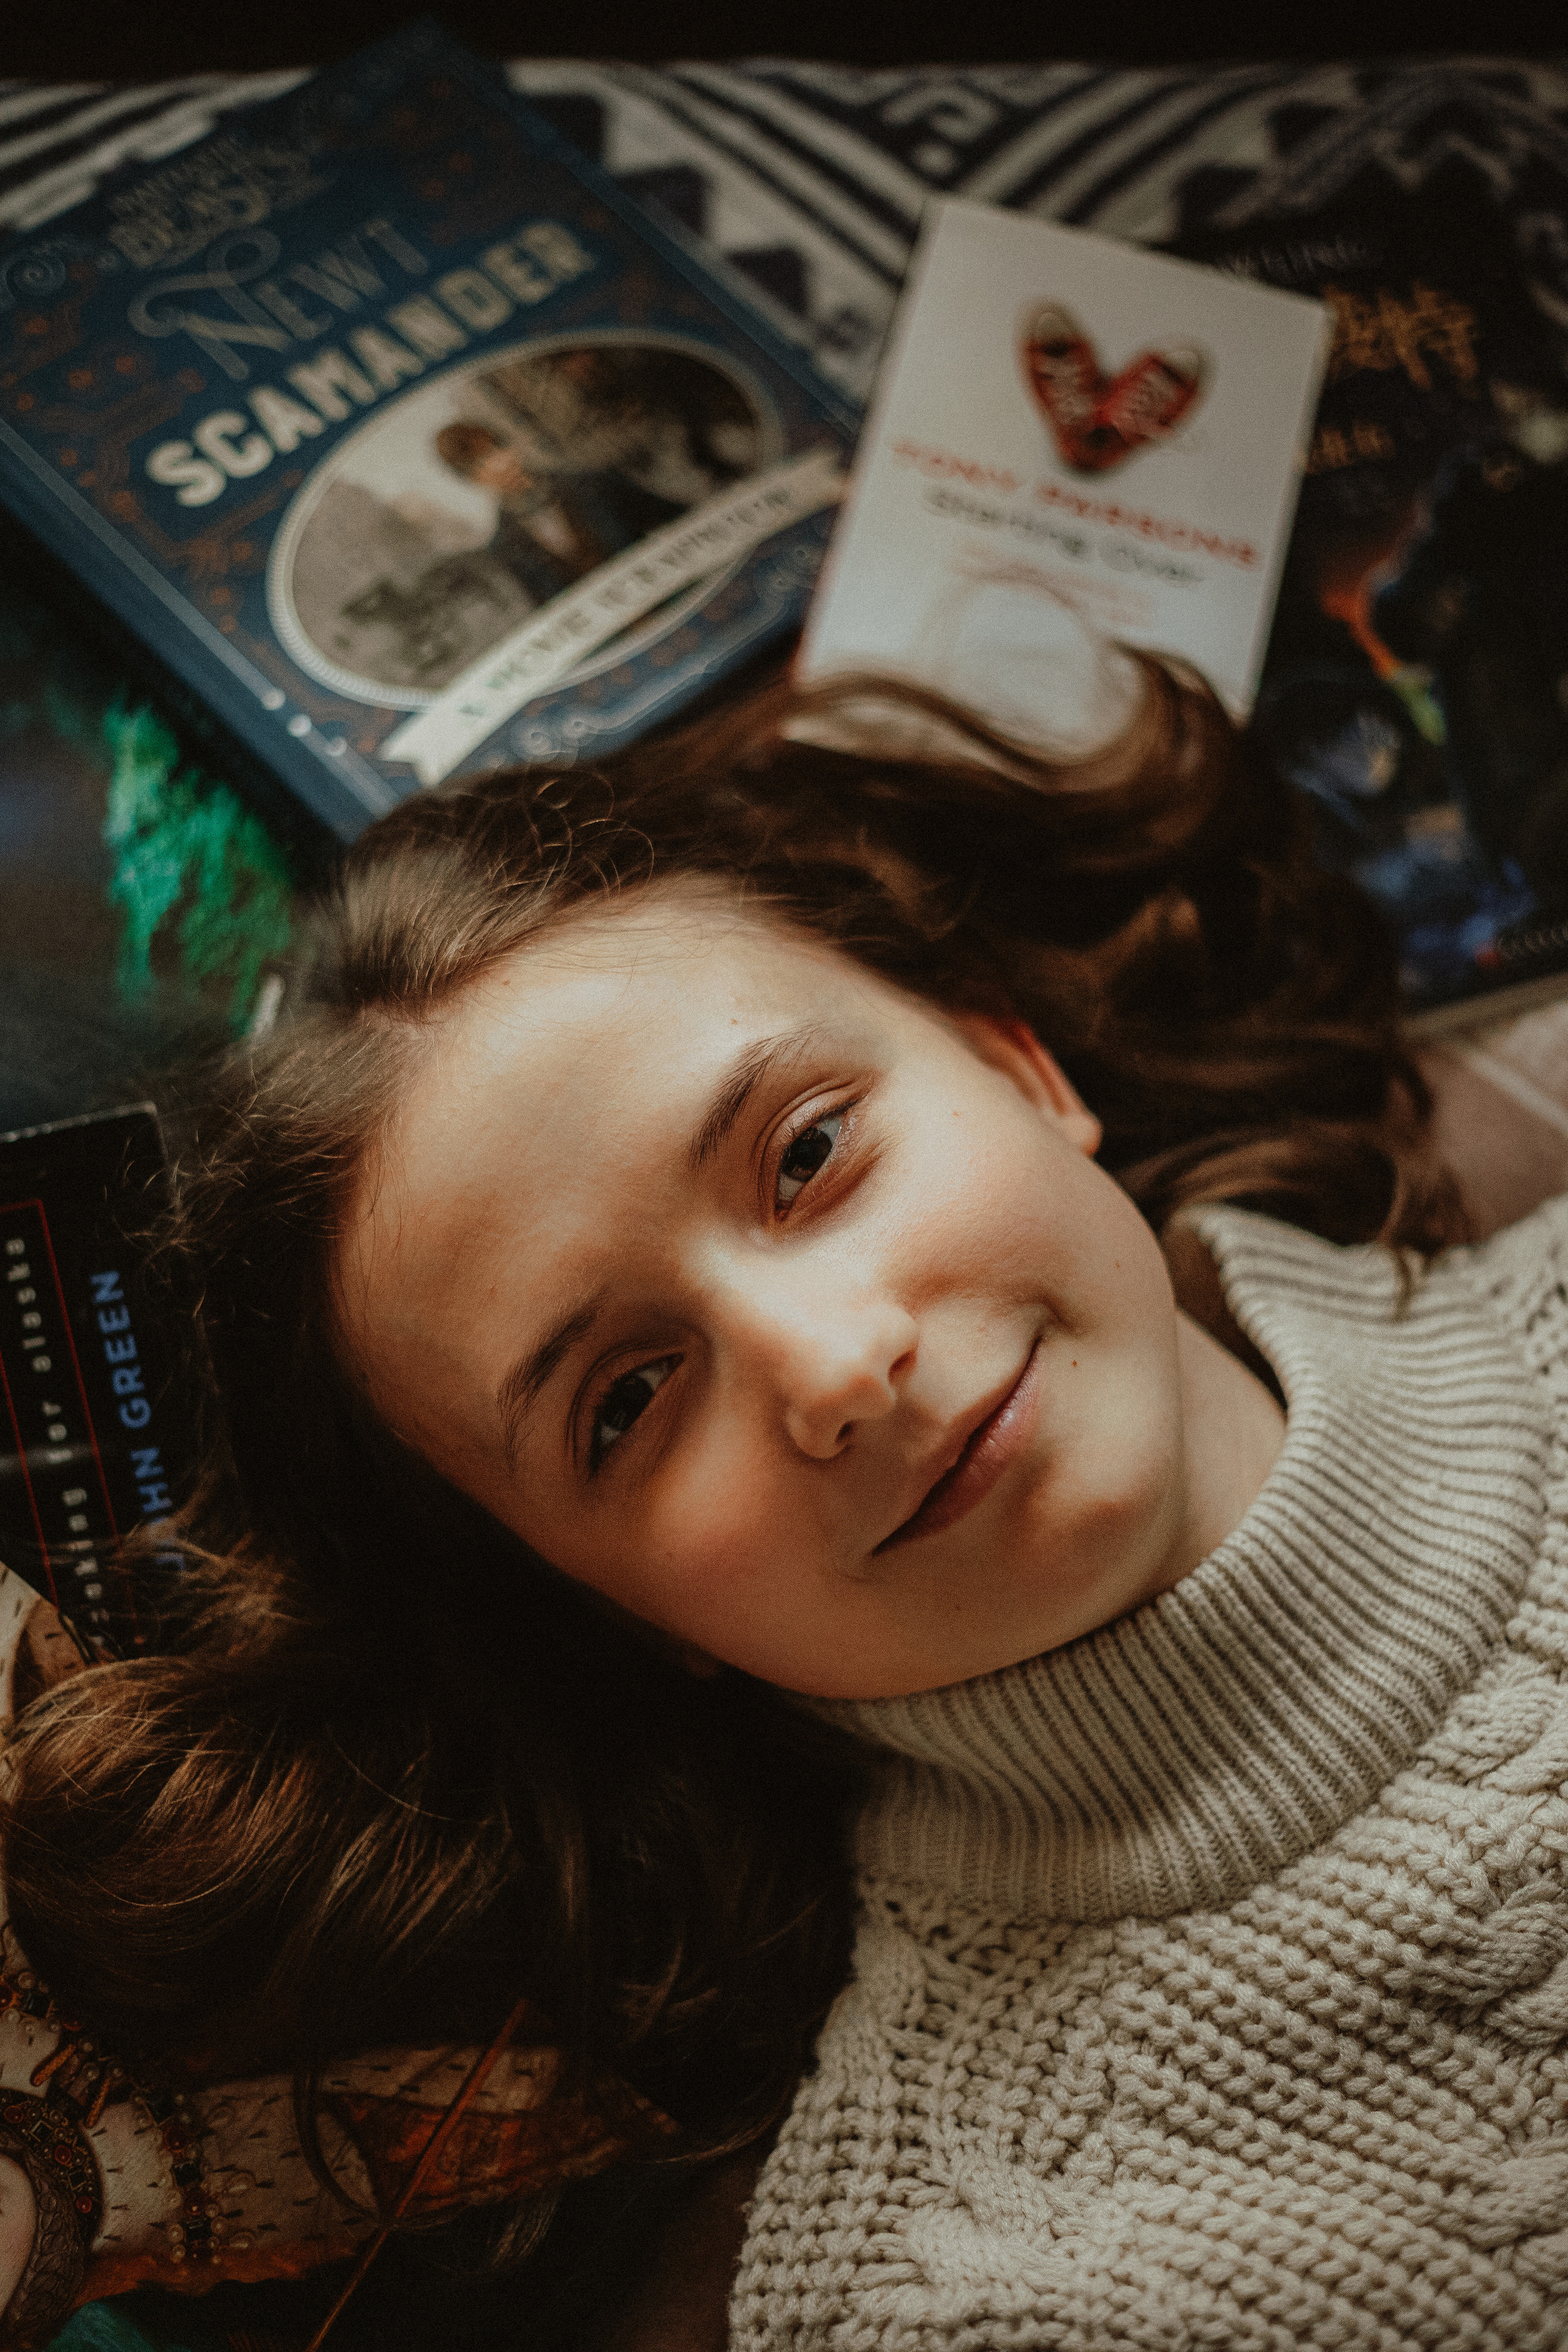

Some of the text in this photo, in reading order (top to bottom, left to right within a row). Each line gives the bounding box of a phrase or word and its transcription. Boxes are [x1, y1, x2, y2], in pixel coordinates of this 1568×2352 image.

[127, 216, 430, 382] NEWT
[144, 222, 596, 510] SCAMANDER
[4, 1236, 53, 1376] alaska
[91, 1270, 153, 1430] GREEN
[40, 1399, 74, 1464] for
